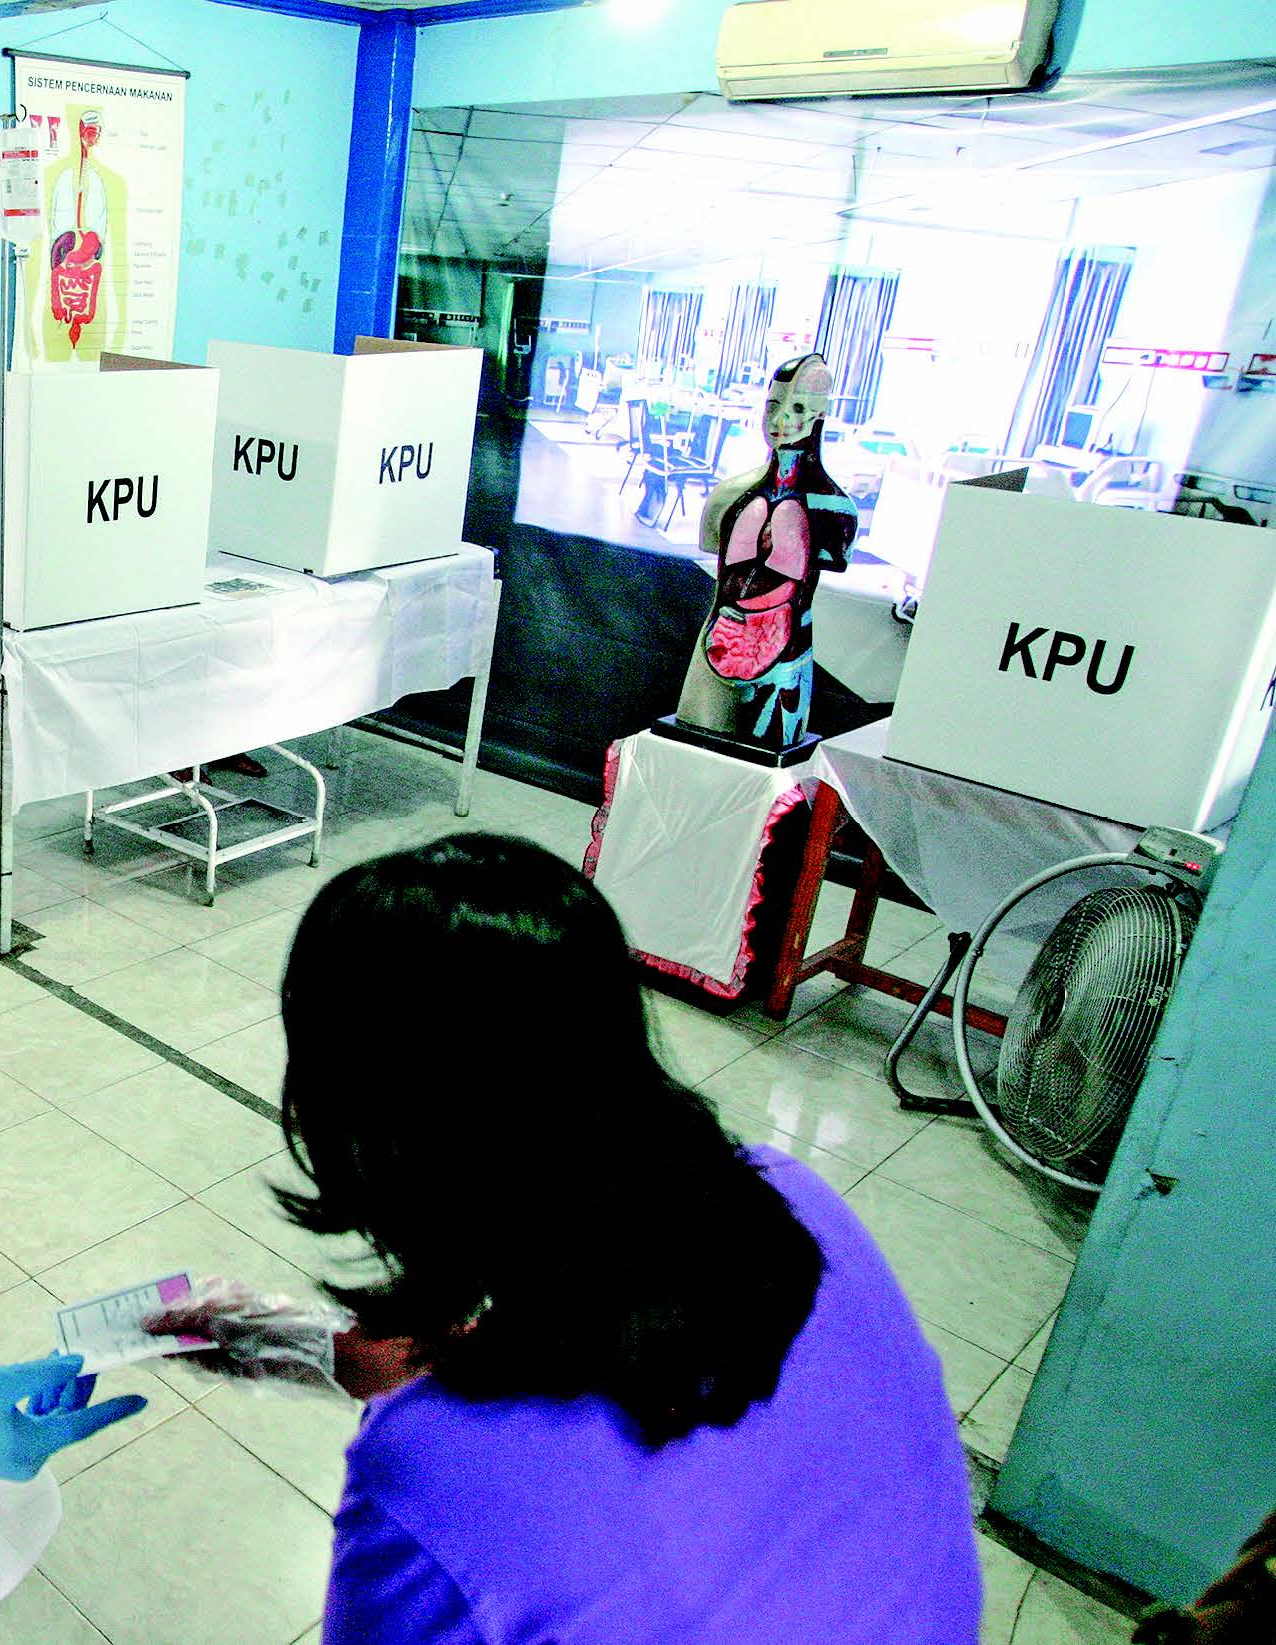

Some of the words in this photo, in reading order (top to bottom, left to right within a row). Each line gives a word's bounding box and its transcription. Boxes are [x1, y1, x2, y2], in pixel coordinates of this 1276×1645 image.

[27, 76, 63, 90] SISTEM
[65, 80, 127, 96] PENCERNAAN
[129, 87, 173, 102] MAKANAN
[233, 434, 299, 482] KPU
[378, 442, 434, 485] KPU
[86, 474, 159, 524] KPU
[998, 621, 1135, 695] KPU
